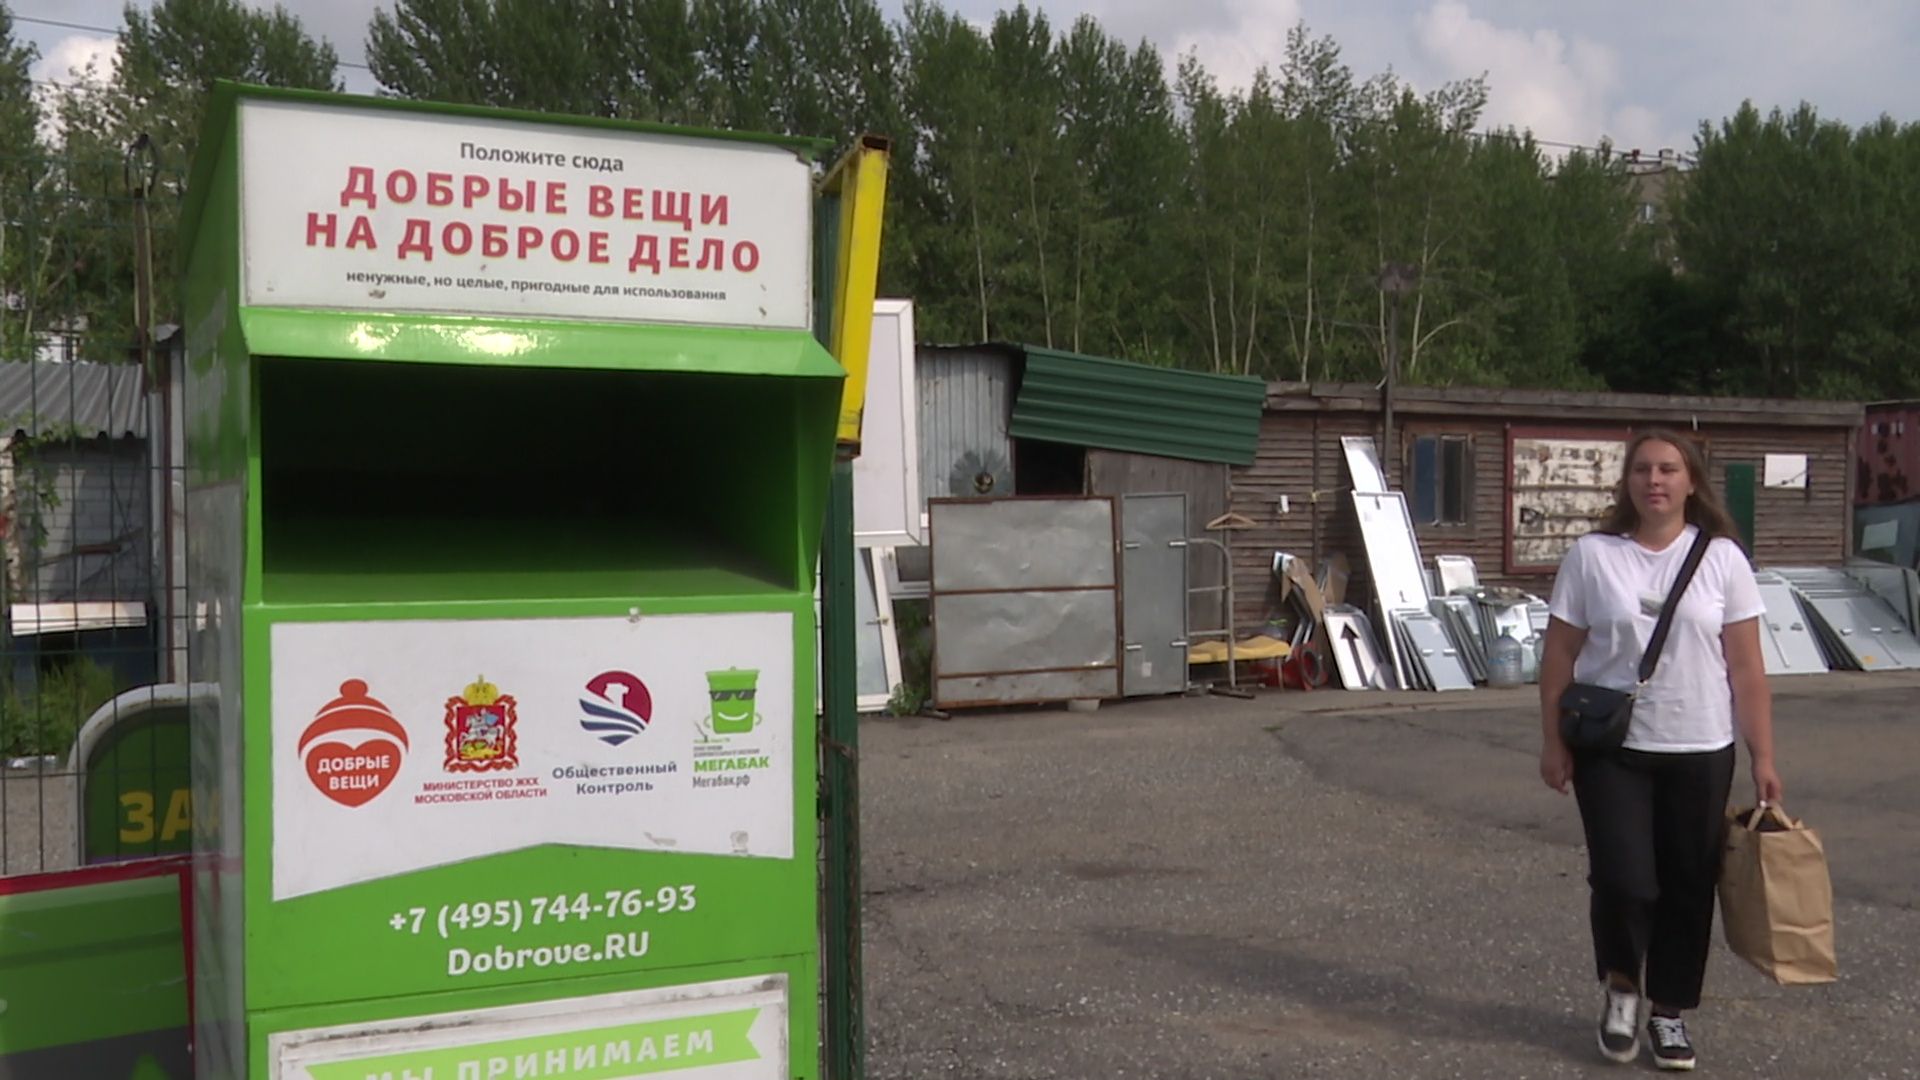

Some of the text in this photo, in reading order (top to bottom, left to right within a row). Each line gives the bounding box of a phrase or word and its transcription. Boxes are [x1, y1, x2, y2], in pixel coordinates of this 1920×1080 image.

[460, 142, 624, 173] Положите сюда
[340, 165, 729, 232] ДОБРЫЕ ВЕЩИ
[305, 212, 760, 275] НА ДОБРОЕ ДЕЛО
[346, 271, 727, 300] ненужные, но целые, пригодные для использования
[317, 754, 390, 774] ДОБРЫЕ
[552, 760, 677, 780] Общественный
[694, 756, 769, 773] МЕГАБАК
[328, 774, 380, 791] ВЕЩИ
[423, 777, 539, 791] МИНИСТЕРСТВО ЖКХ
[576, 781, 654, 796] Контроль
[692, 774, 751, 788] Мегабак.рф
[414, 788, 547, 804] МОСКОВСКОЙ ОБЛАСТИ
[389, 884, 697, 938] +7 (495) 744-76-93
[447, 931, 650, 976] Dobrove.RU
[458, 1028, 714, 1080] ПРИНИМАЕМ
